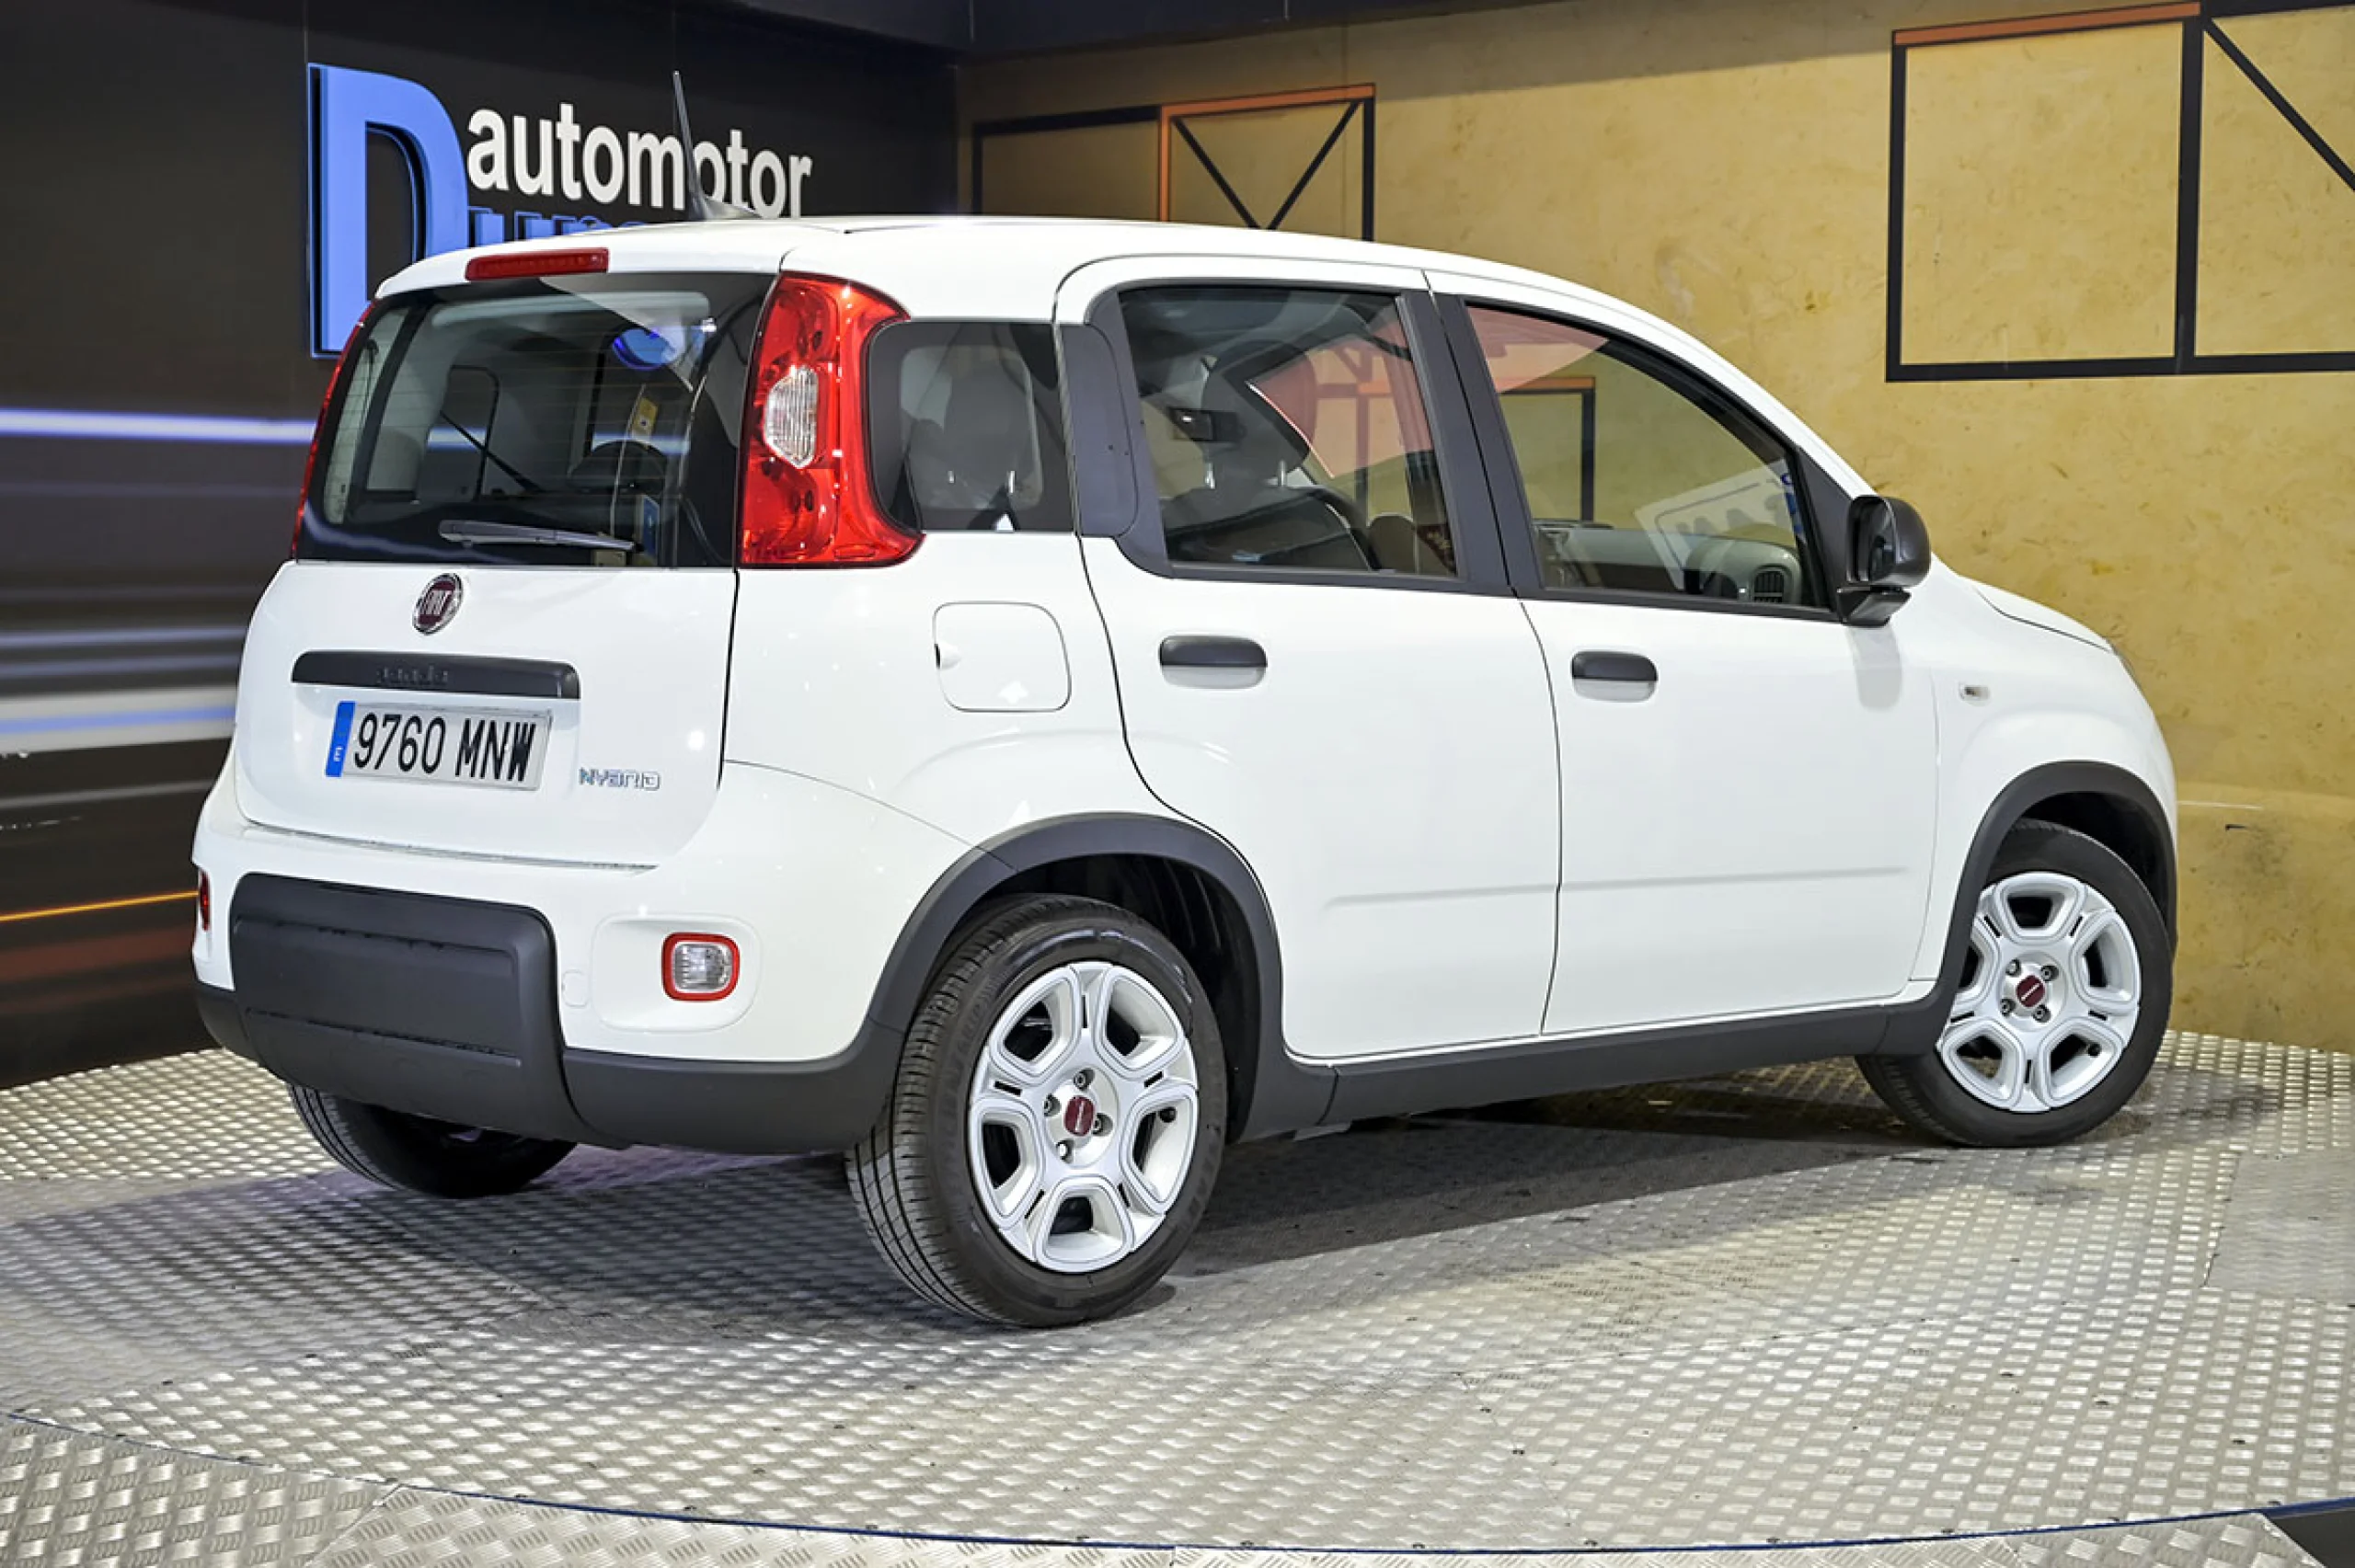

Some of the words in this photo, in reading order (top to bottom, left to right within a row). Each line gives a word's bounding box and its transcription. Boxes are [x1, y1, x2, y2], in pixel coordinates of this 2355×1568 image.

[467, 102, 811, 218] automotor
[333, 746, 343, 761] E
[353, 712, 446, 774] 9760
[454, 717, 536, 782] MNW
